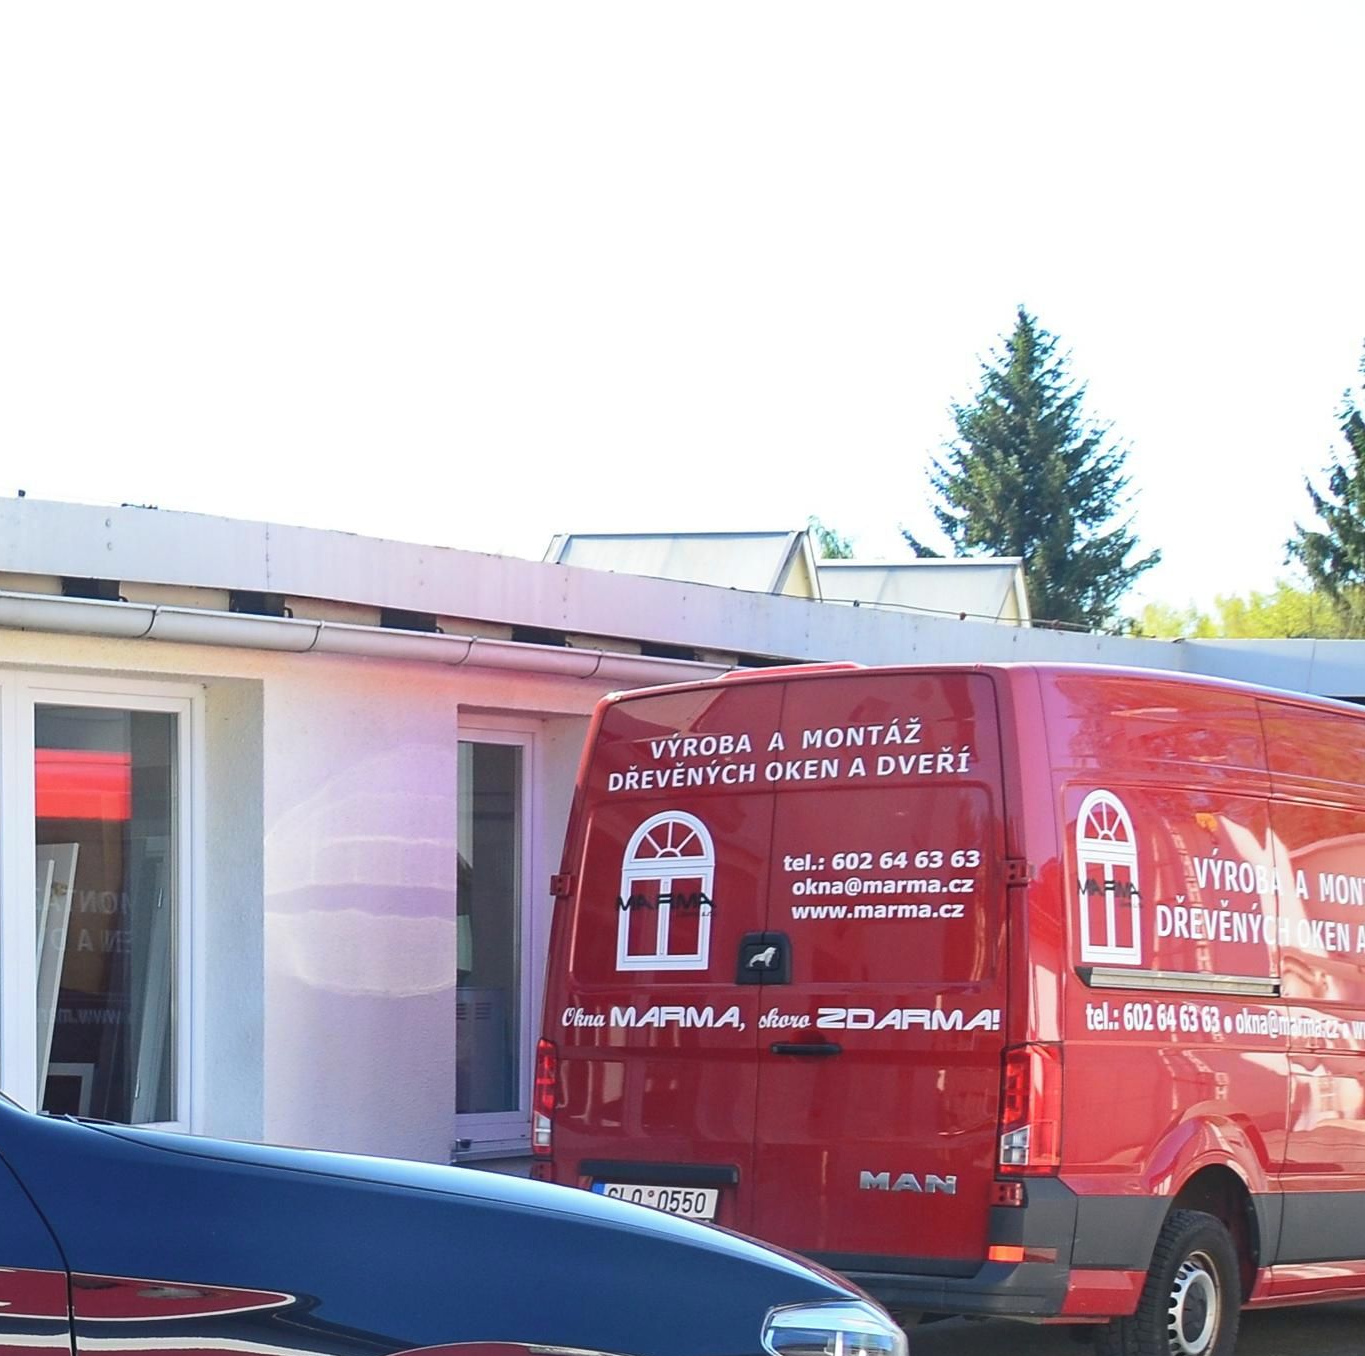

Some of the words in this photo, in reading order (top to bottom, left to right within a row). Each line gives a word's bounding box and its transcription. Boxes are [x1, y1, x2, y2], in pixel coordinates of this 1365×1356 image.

[650, 733, 751, 759] VÝROBA
[767, 731, 785, 751] A
[802, 717, 921, 749] MONTÁŽ
[608, 760, 756, 792] DŘEVĚNÝCH
[765, 758, 839, 781] OKEN
[848, 757, 866, 778] A
[877, 746, 970, 776] DVEŘÍ
[784, 854, 825, 871] tel.:
[831, 853, 873, 870] 602
[879, 851, 908, 869] 64
[914, 850, 943, 868] 63
[951, 850, 980, 868] 63
[792, 878, 974, 896] okna@marma.cz
[1193, 848, 1284, 896] VÝROBA
[1295, 870, 1309, 900] A
[1319, 872, 1365, 906] MON
[792, 904, 965, 919] www.marma.cz
[1156, 895, 1289, 945] DŘEVĚNÝCH
[1296, 919, 1350, 952] OKEN
[561, 1007, 606, 1027] Okna
[610, 1006, 746, 1031] MARMA,
[758, 1008, 811, 1028] skoro
[816, 1008, 1001, 1030] ZDARMA!
[1085, 1001, 1119, 1030] tel.:
[1123, 1003, 1154, 1030] 602
[1156, 1004, 1177, 1031] 64
[1179, 1005, 1199, 1032] 63
[1201, 1006, 1221, 1032] 63
[1235, 1007, 1339, 1038] okna@marma.cz
[859, 1170, 957, 1195] MAN
[657, 1190, 707, 1214] 0550
